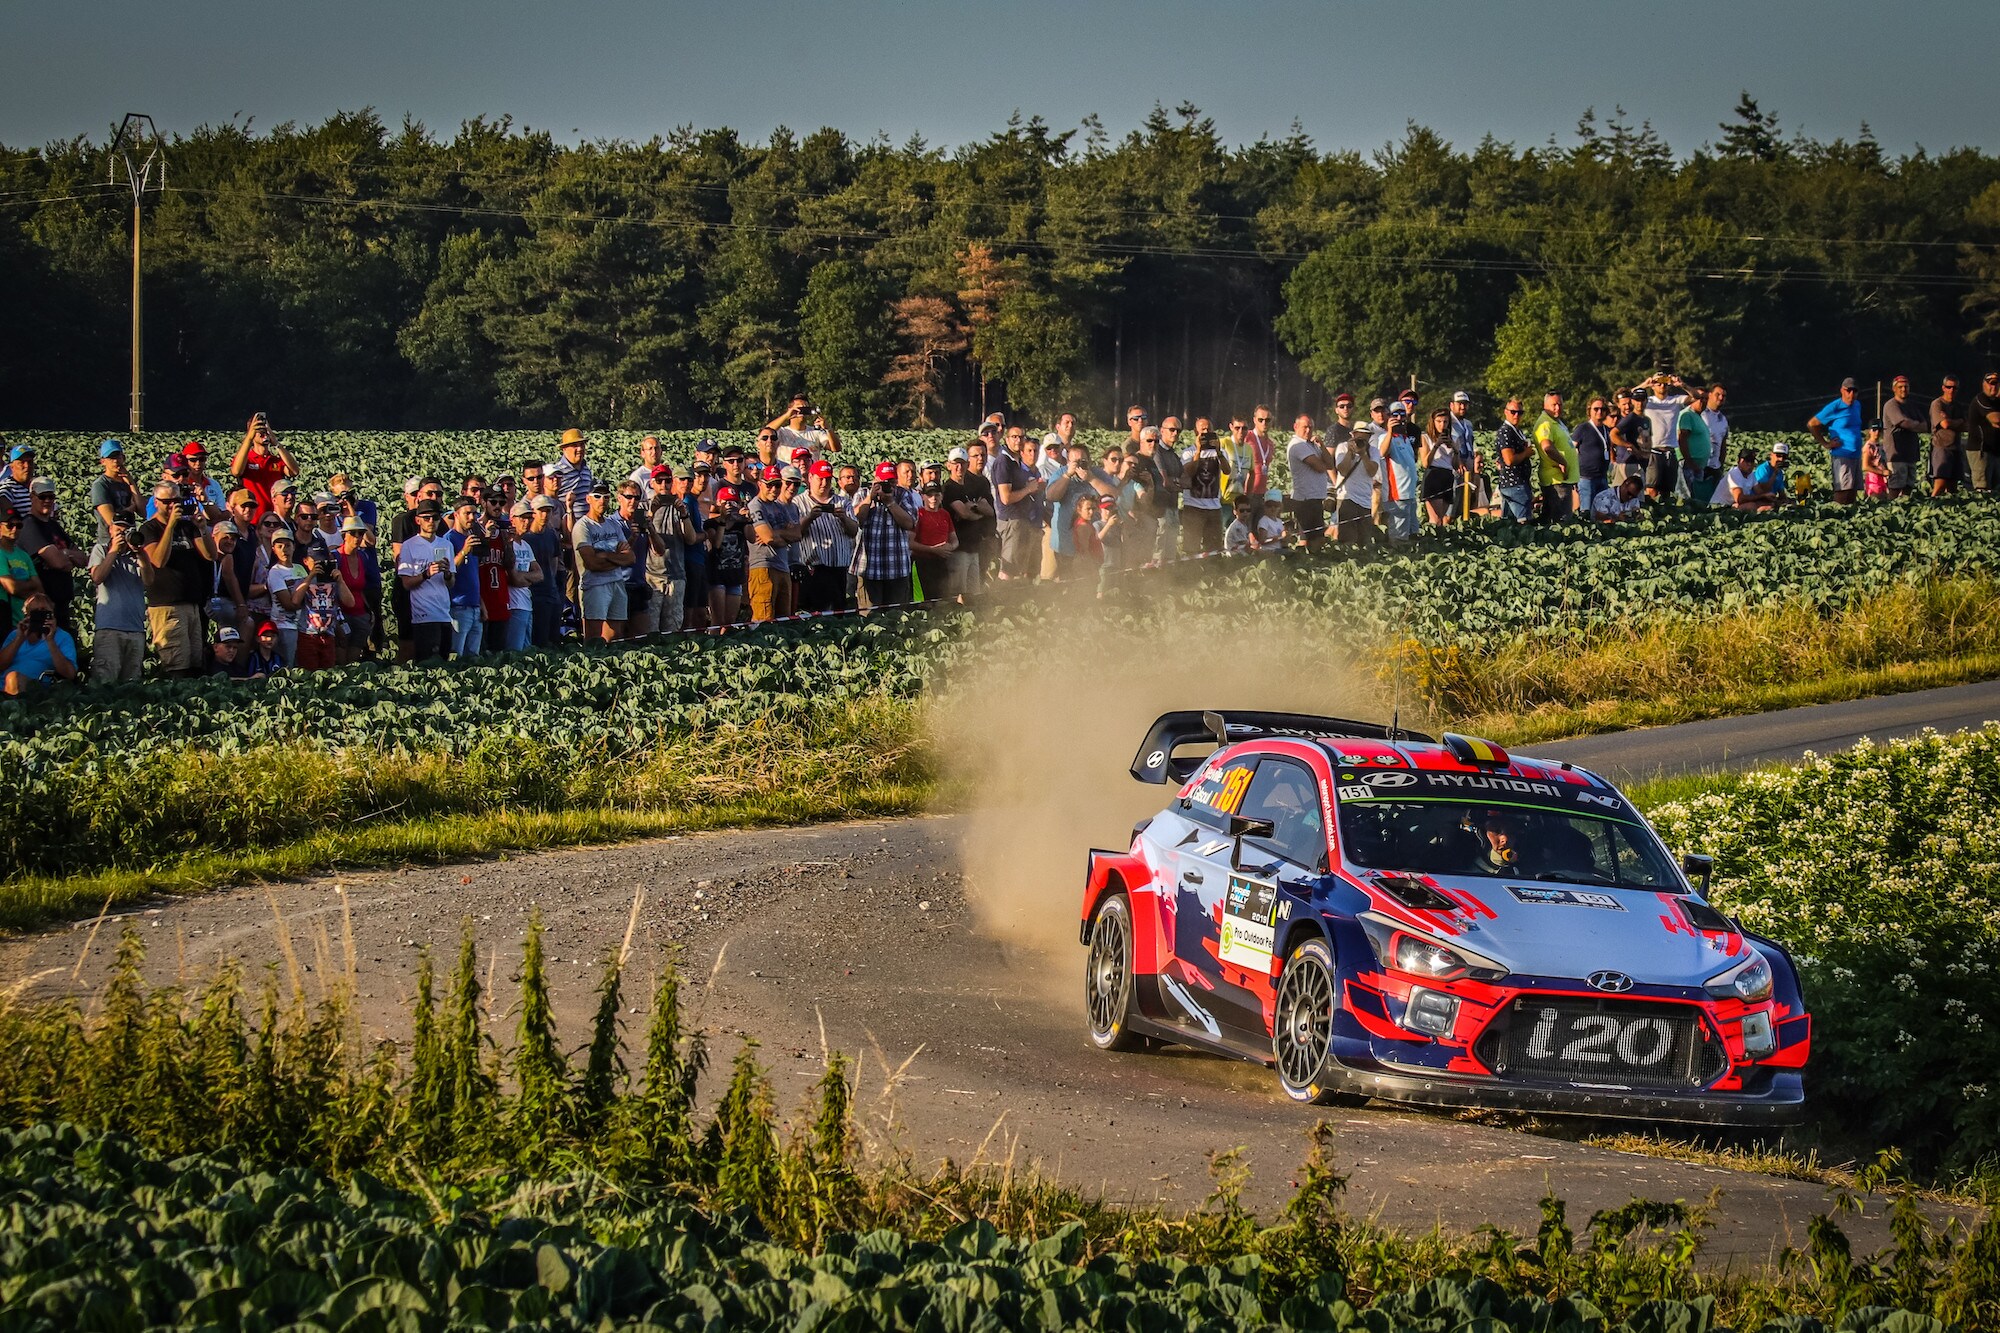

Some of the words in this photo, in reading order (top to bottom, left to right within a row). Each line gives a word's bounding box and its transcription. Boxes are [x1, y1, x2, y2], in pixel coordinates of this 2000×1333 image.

[490, 566, 500, 589] 1
[1215, 766, 1254, 815] 151
[1341, 786, 1369, 798] 151
[1426, 773, 1562, 798] HYUNDAI
[1229, 893, 1249, 905] RALLY
[1231, 885, 1251, 898] YPRES
[1579, 894, 1608, 904] 151
[1252, 912, 1267, 924] 2019
[1234, 926, 1242, 939] Pro
[1244, 930, 1265, 946] Outdoor
[1526, 1008, 1674, 1066] i20
